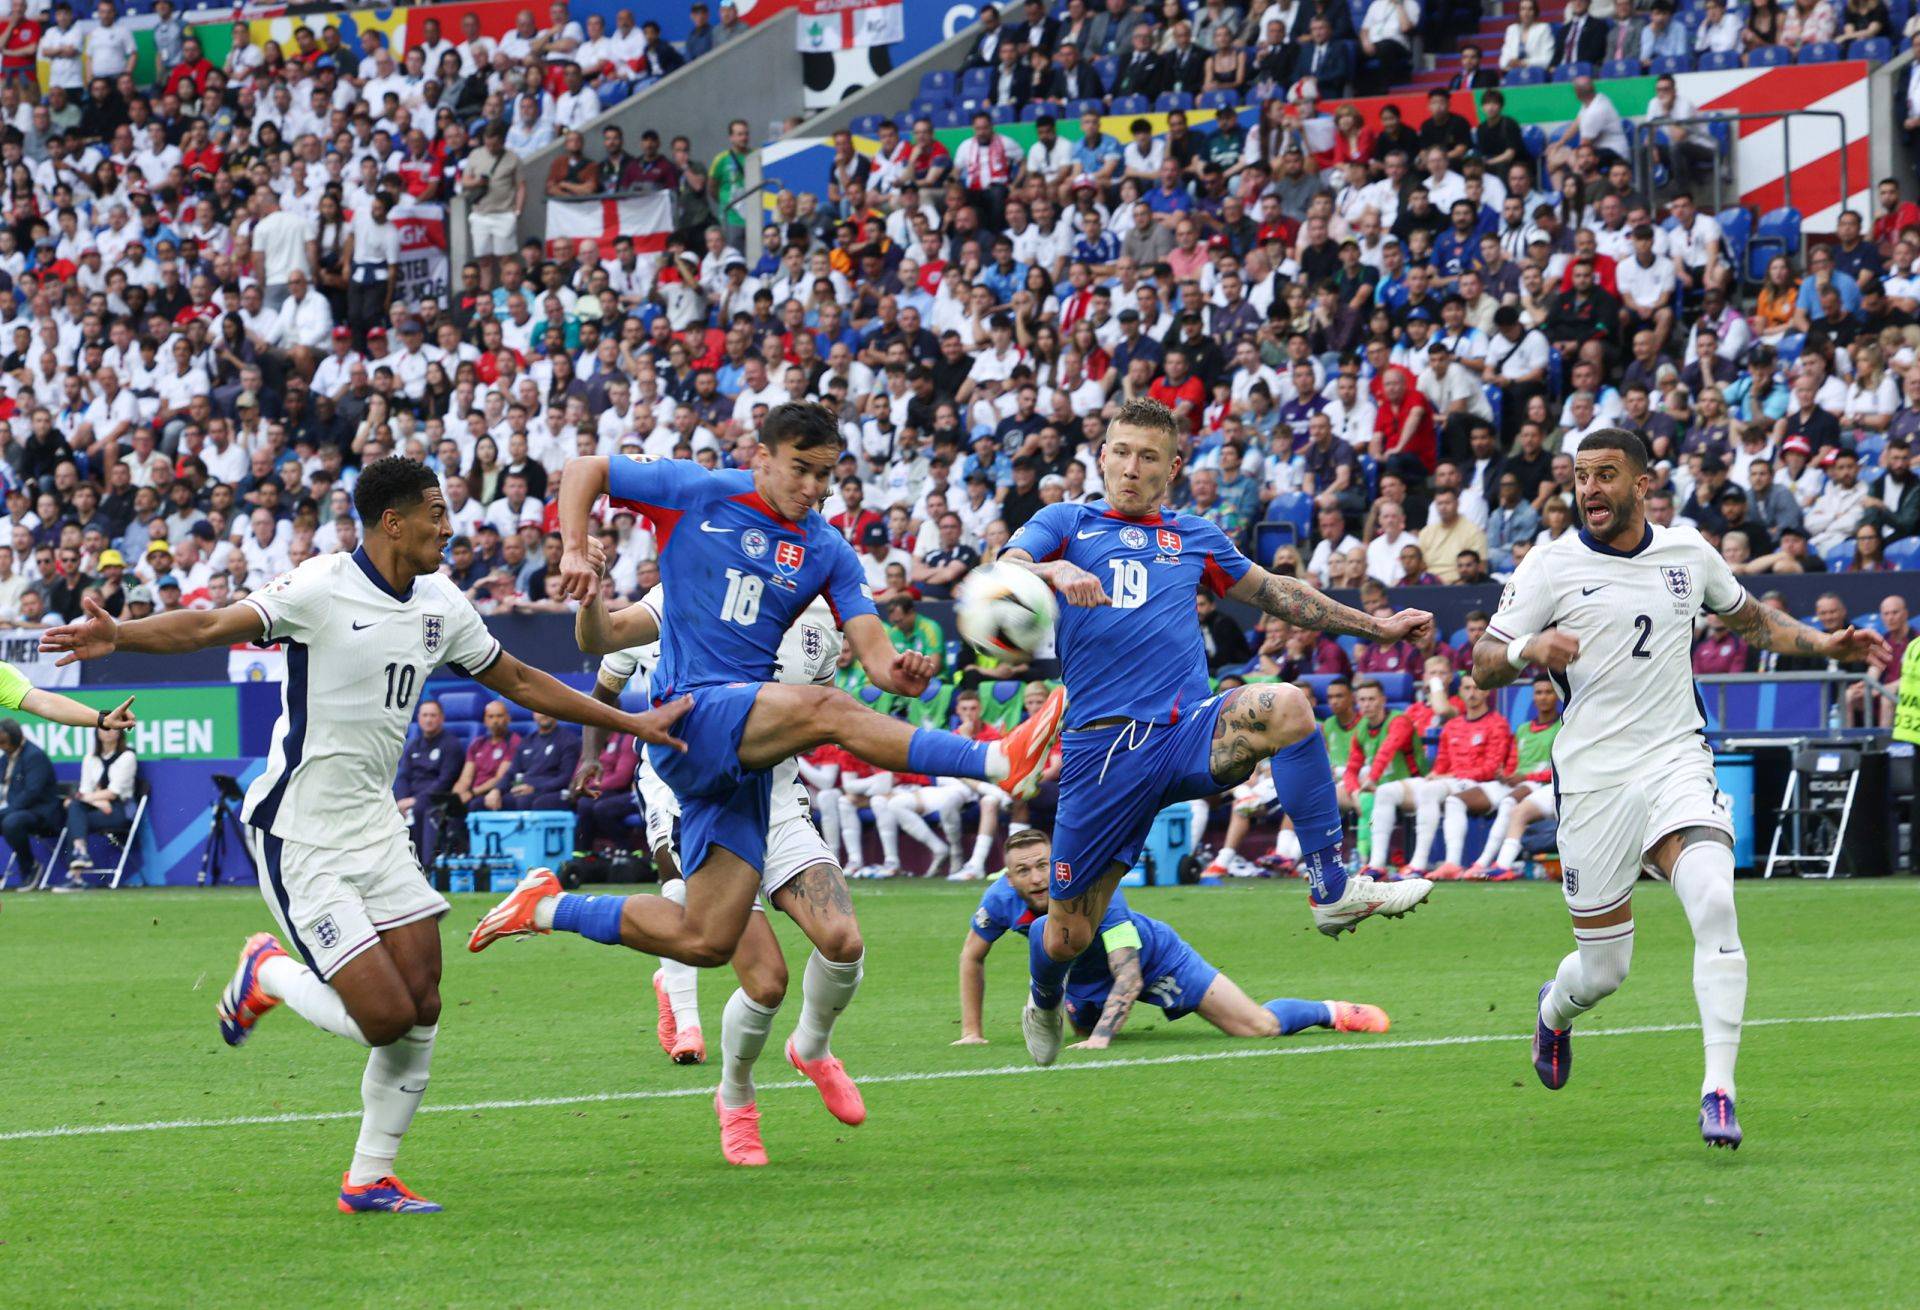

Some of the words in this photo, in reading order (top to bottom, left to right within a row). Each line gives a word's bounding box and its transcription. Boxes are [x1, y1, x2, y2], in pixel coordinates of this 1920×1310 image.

[720, 568, 765, 626] 18
[1109, 559, 1148, 609] 19
[1632, 614, 1653, 659] 2
[384, 662, 416, 710] 10
